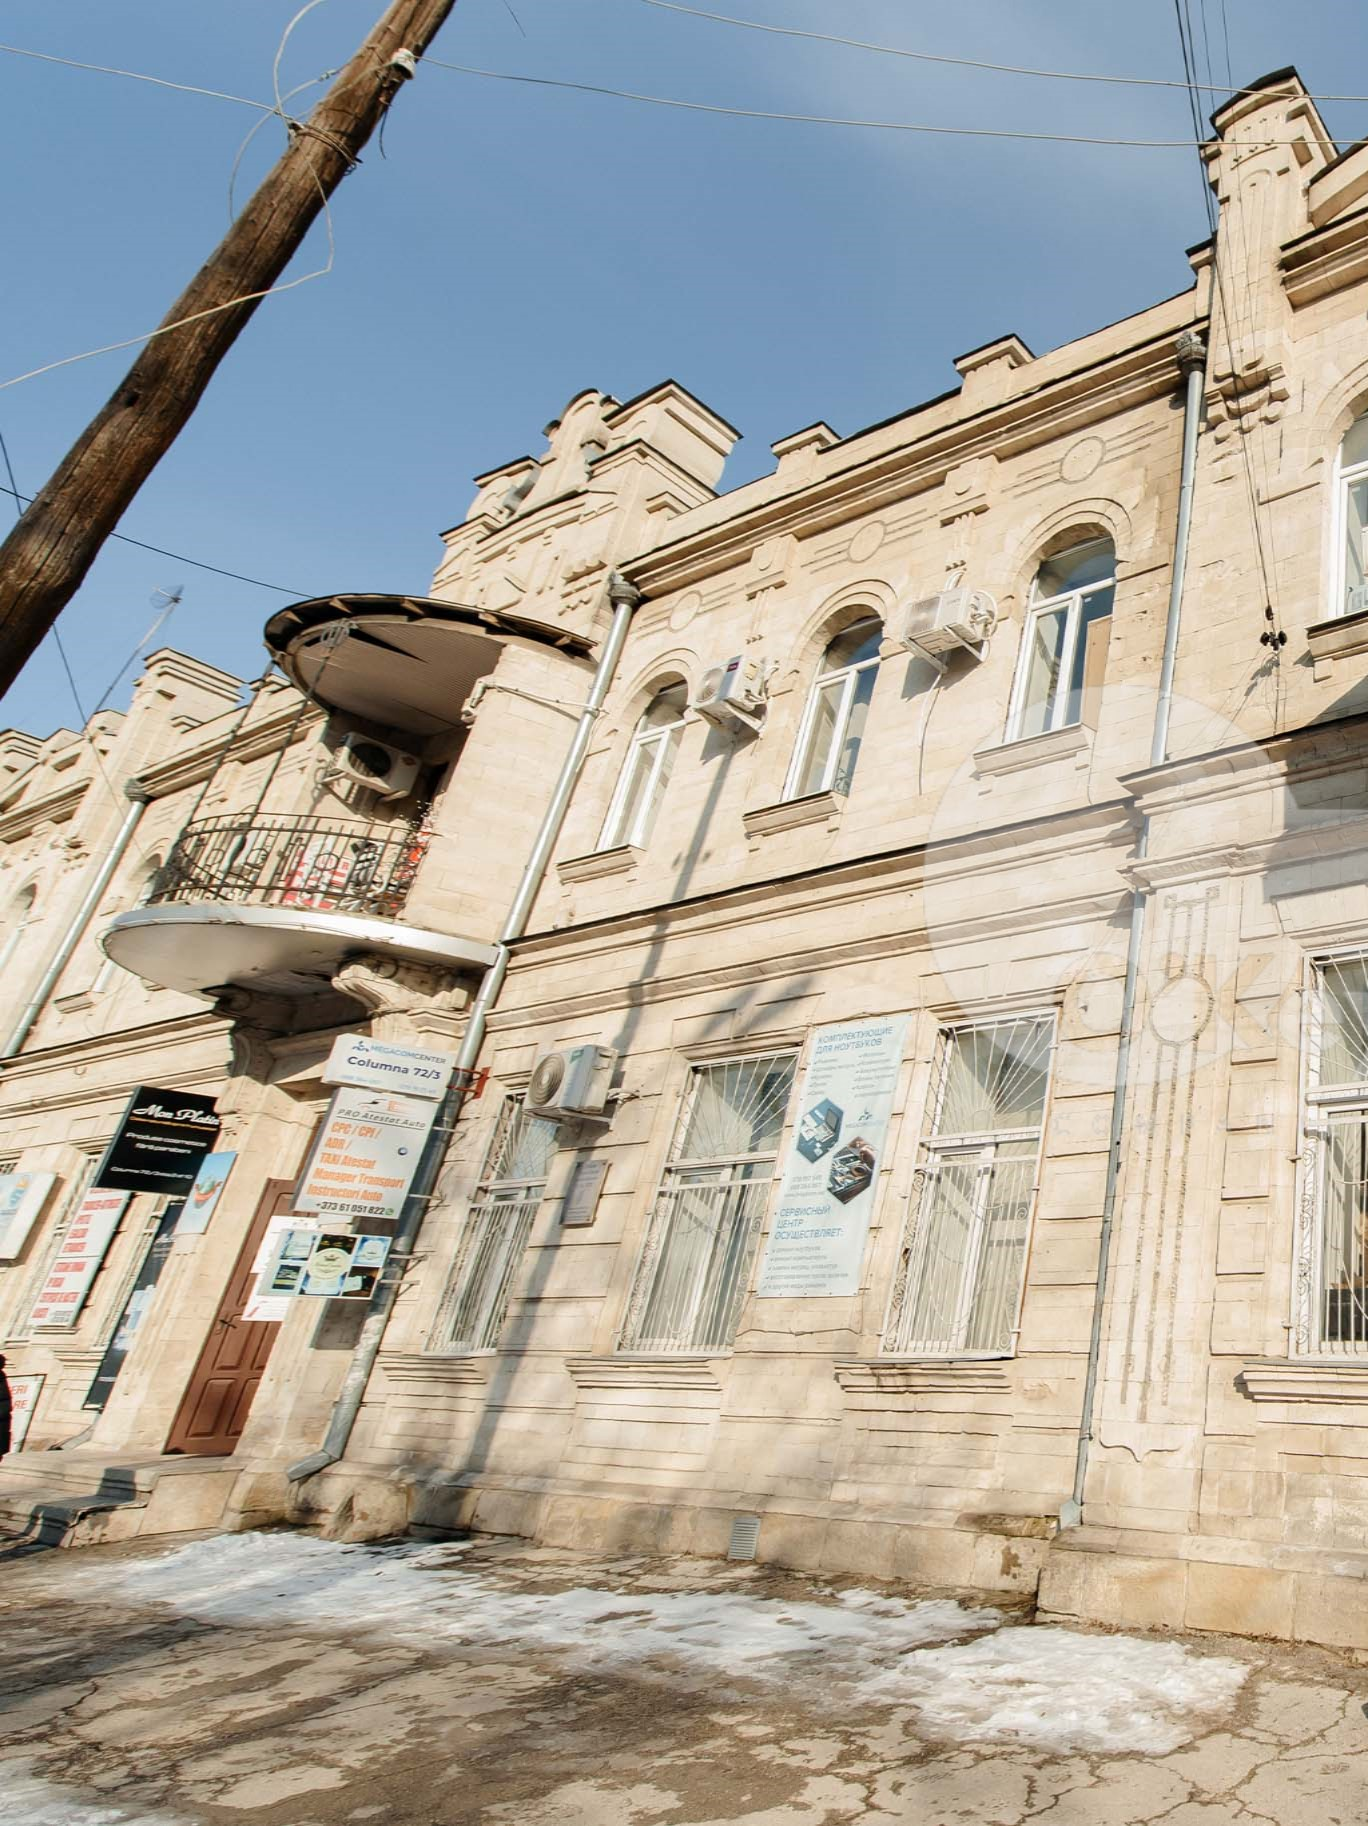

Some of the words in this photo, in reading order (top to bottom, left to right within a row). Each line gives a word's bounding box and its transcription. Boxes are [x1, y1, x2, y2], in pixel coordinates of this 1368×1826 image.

[834, 1038, 883, 1052] НОУТБУКОВ
[347, 1056, 409, 1074] Columna
[413, 1067, 441, 1080] 72/3
[337, 1108, 360, 1118] PRO
[361, 1112, 401, 1125] Atestat
[401, 1118, 426, 1128] Auto
[359, 1174, 405, 1188] Transport
[315, 1202, 337, 1210] +373
[339, 1203, 350, 1211] 61
[367, 1206, 385, 1215] 822
[779, 1204, 831, 1217] СЕРВИСНЫЙ
[777, 1219, 804, 1229] ЦЕНТР
